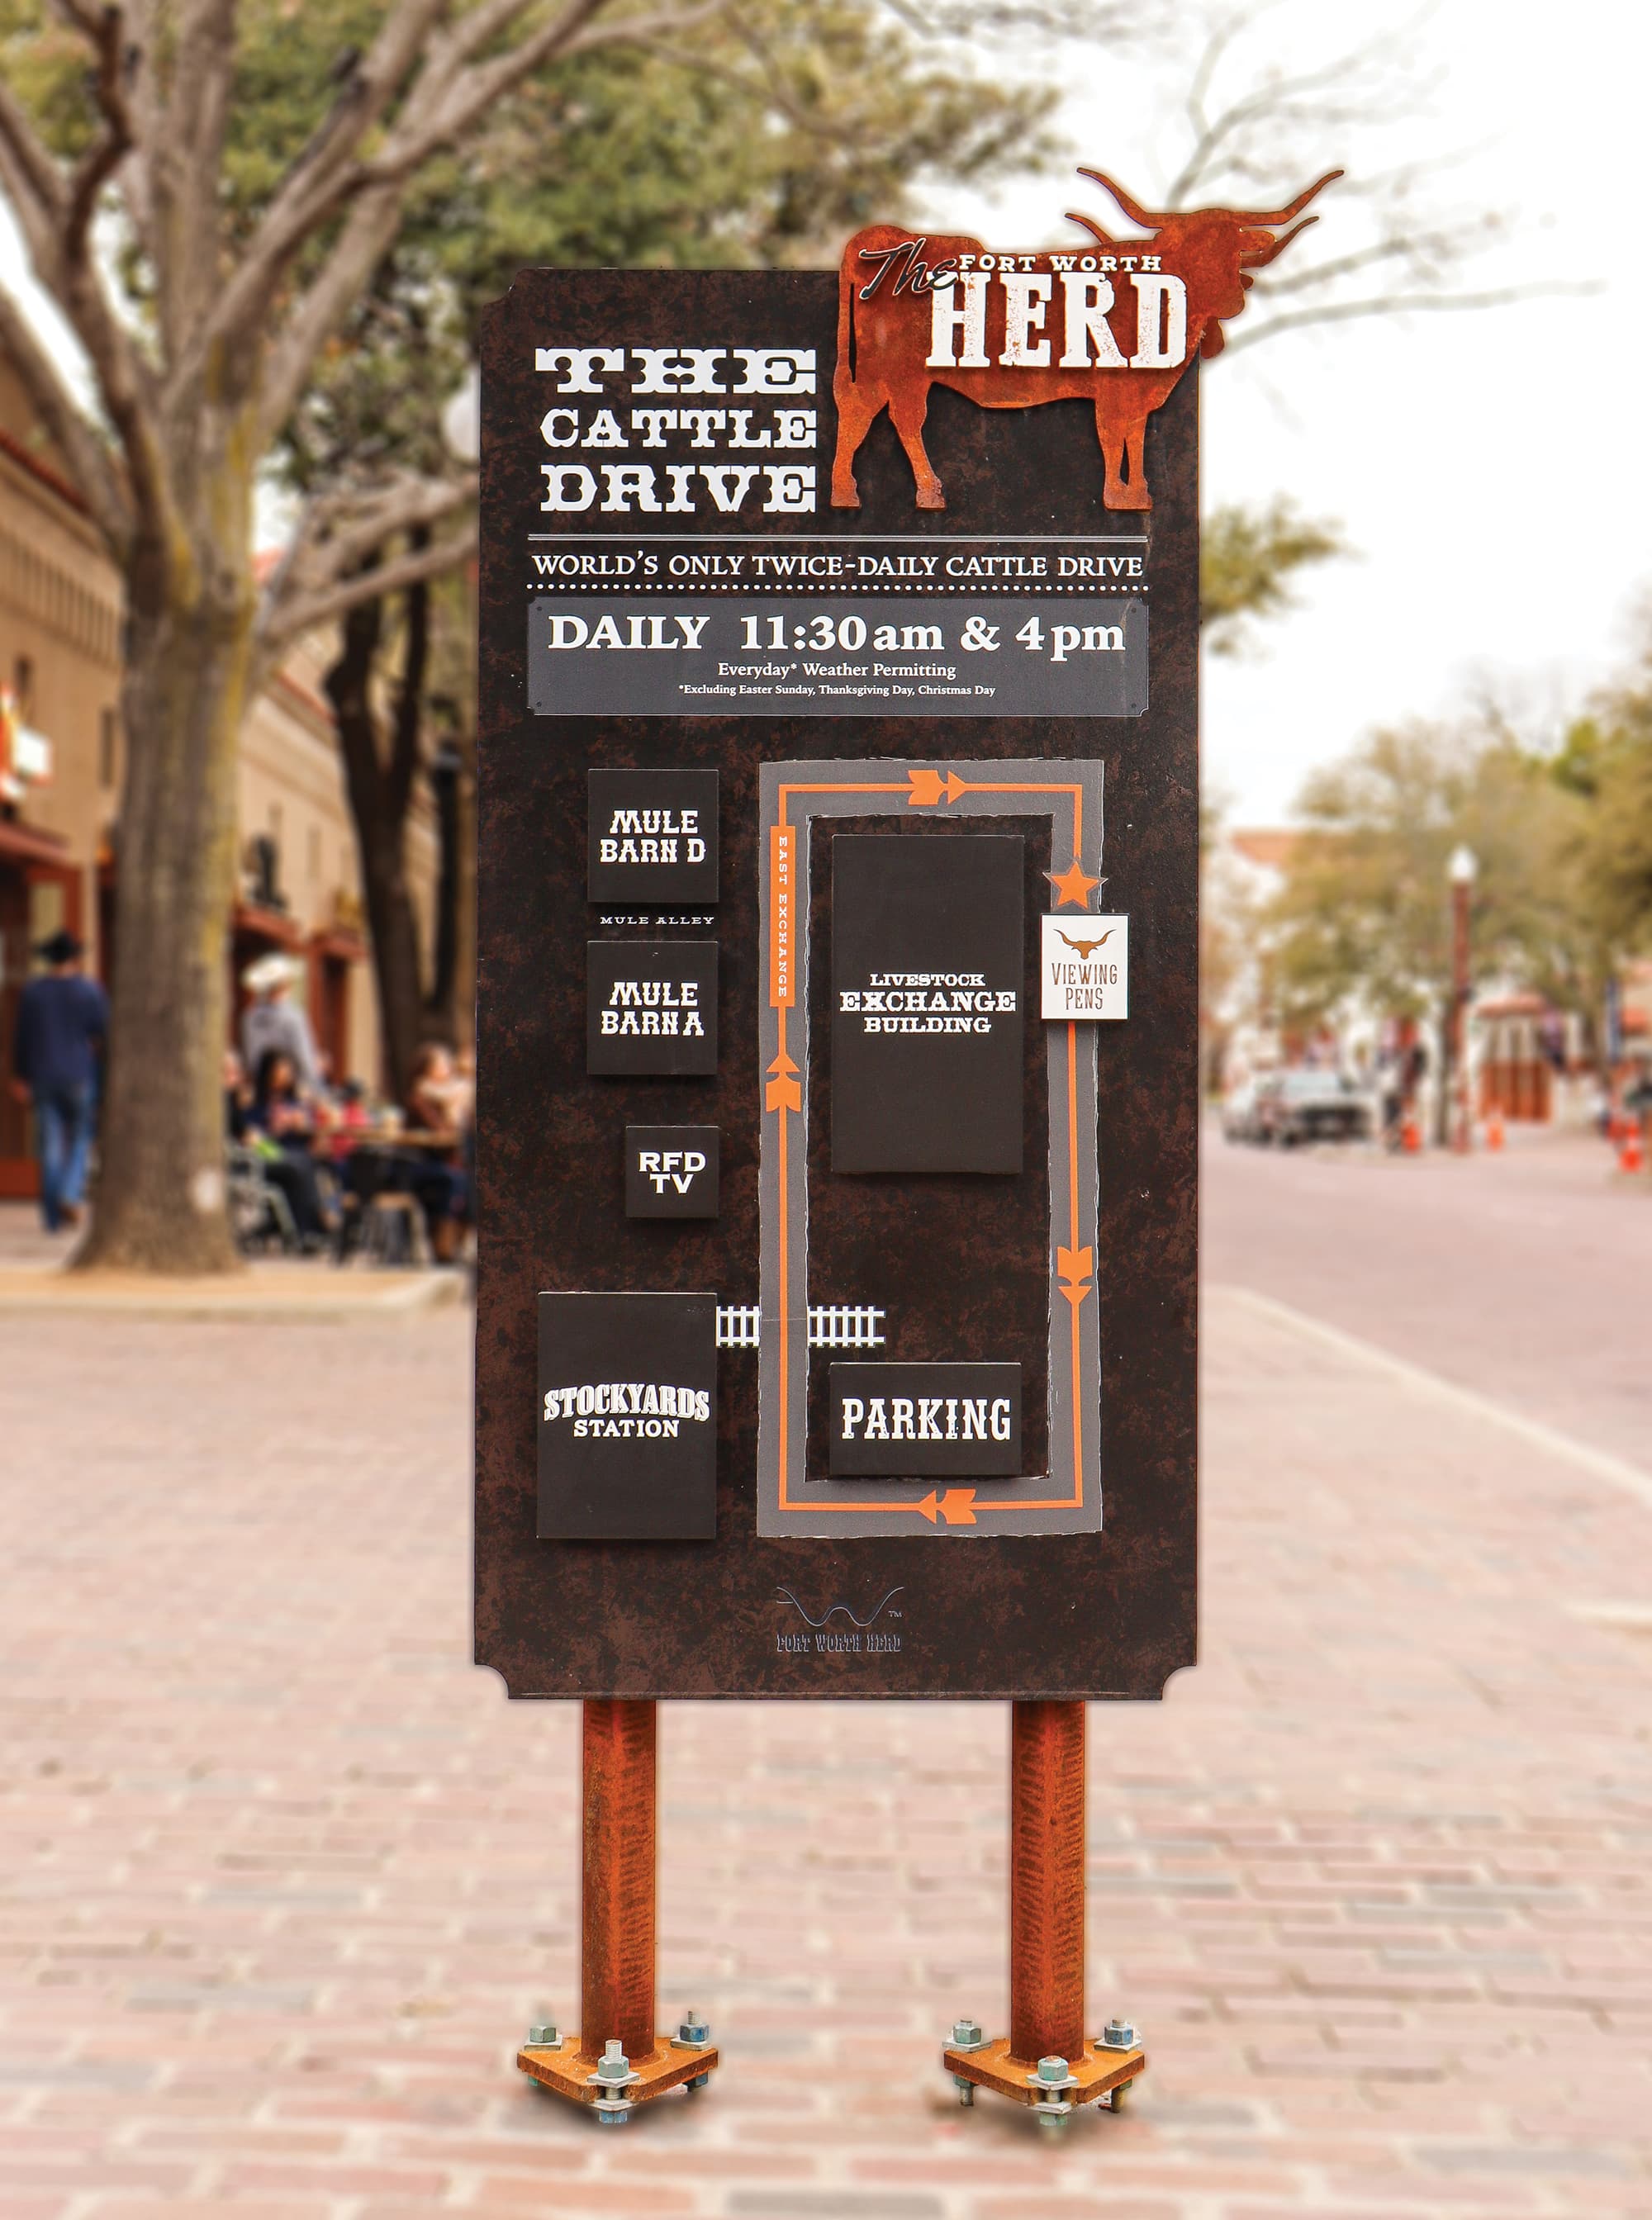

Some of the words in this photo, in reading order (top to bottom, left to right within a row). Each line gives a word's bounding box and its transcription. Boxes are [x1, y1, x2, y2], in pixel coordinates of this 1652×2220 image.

[858, 237, 958, 301] The
[958, 254, 1036, 272] FORT
[1049, 255, 1162, 273] WORTH
[925, 272, 1187, 368] HERD
[534, 348, 816, 395] THE
[539, 408, 817, 448] CATTLE
[540, 464, 816, 513] DRIVE
[531, 550, 658, 576] WORLD'S
[668, 554, 745, 576] ONLY
[751, 555, 939, 576] TWICE-DAILY
[945, 556, 1048, 576] CATTLE
[1057, 557, 1143, 576] DRIVE
[548, 615, 710, 649] DAILY
[960, 616, 1001, 652] &
[801, 662, 869, 676] Weather
[873, 662, 957, 681] Permitting
[738, 685, 773, 695] Easter
[775, 684, 816, 697] Sunday,
[818, 684, 889, 697] Thanksgiving
[891, 685, 915, 698] Day,
[918, 685, 972, 695] Christmas
[974, 685, 996, 698] Day
[609, 809, 699, 834] MULE
[600, 838, 678, 863] BARN
[686, 837, 707, 863] D
[778, 836, 788, 885] EAST
[600, 916, 649, 925] MULE
[655, 917, 714, 925] ALLEY
[778, 893, 787, 997] EXCHANGE
[870, 973, 986, 987] LIVESTOCK
[1051, 962, 1118, 985] VIEWING
[609, 981, 698, 1007] MULE
[839, 991, 1016, 1013] EXCHANGE
[1066, 987, 1103, 1011] PENS
[863, 1017, 992, 1033] BUILDING
[638, 1150, 706, 1172] RFD
[649, 1173, 695, 1194] TV
[544, 1383, 710, 1422] STOCKYARDS
[573, 1419, 680, 1438] STATION
[842, 1398, 1011, 1441] PARKING
[776, 1633, 811, 1652] FORT
[814, 1633, 862, 1652] WORTH
[866, 1633, 902, 1652] HERD
